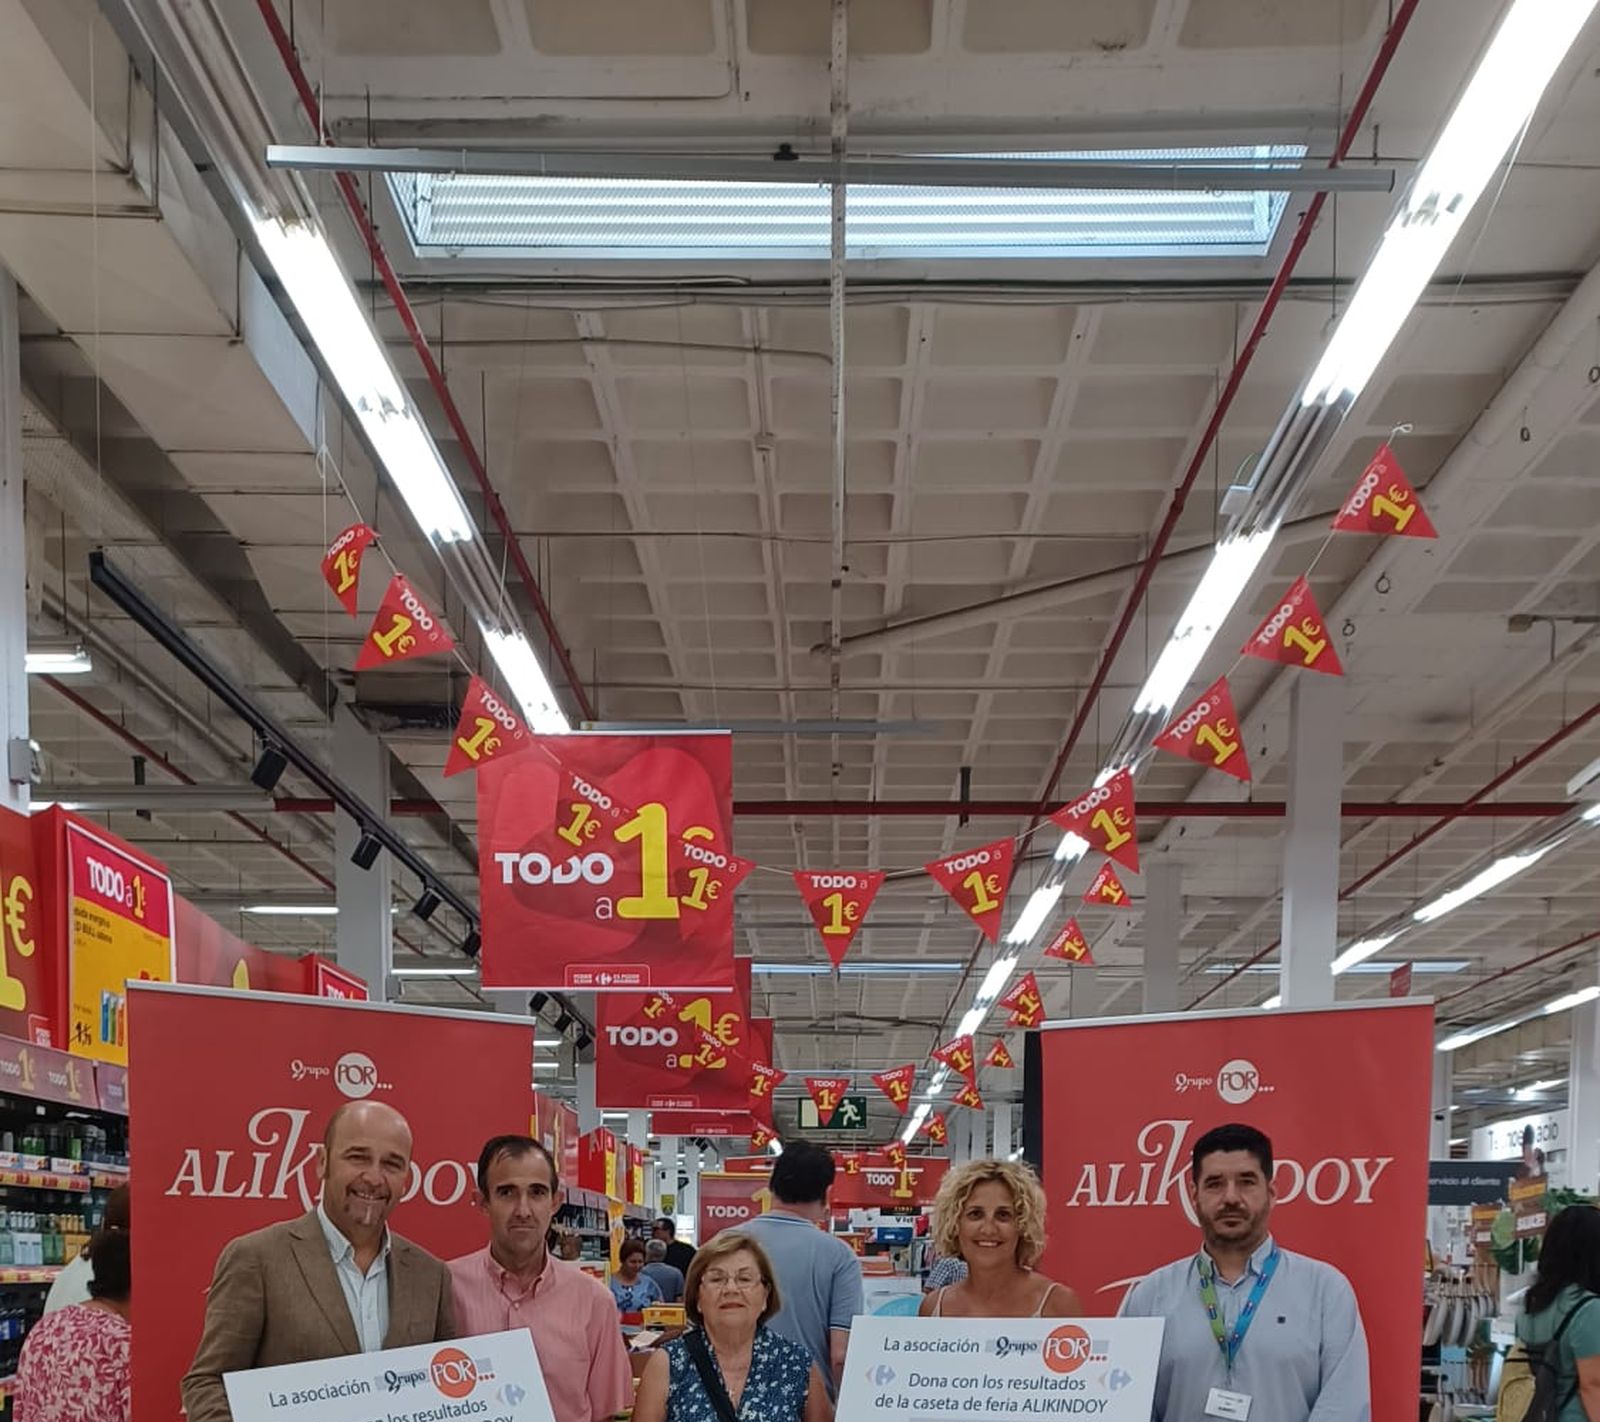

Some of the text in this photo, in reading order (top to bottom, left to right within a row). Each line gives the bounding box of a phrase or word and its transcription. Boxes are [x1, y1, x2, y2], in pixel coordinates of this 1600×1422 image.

[1344, 474, 1379, 516] TODO
[1372, 484, 1416, 532] 1€
[334, 549, 357, 594] 1€
[400, 588, 433, 631] TODO
[1256, 604, 1293, 645] TODO
[373, 614, 416, 657] 1€
[1283, 617, 1326, 665] 1€
[480, 691, 517, 731] TODO
[1170, 702, 1211, 740] TODO
[458, 717, 501, 761] 1€
[1196, 718, 1238, 765] 1€
[571, 776, 612, 810] TODO
[1068, 787, 1111, 820] TODO
[558, 803, 601, 847] 1€
[1091, 807, 1132, 851] 1€
[494, 853, 614, 884] TODO
[684, 843, 727, 869] TODO
[944, 851, 990, 875] TODO
[87, 856, 124, 901] TODO
[681, 867, 722, 910] 1€
[811, 875, 856, 889] TODO
[963, 871, 1002, 914] 1€
[823, 893, 859, 934] 1€
[605, 1026, 678, 1046] TODO
[866, 1173, 895, 1186] TODO
[706, 1205, 749, 1218] TODO
[884, 1337, 900, 1351] La
[904, 1338, 980, 1353] asociación
[269, 1391, 288, 1408] La
[291, 1379, 371, 1405] asociación
[908, 1373, 1086, 1391] Dona con los resultados
[875, 1394, 1108, 1414] de la caseta de feria ALIKINDOY
